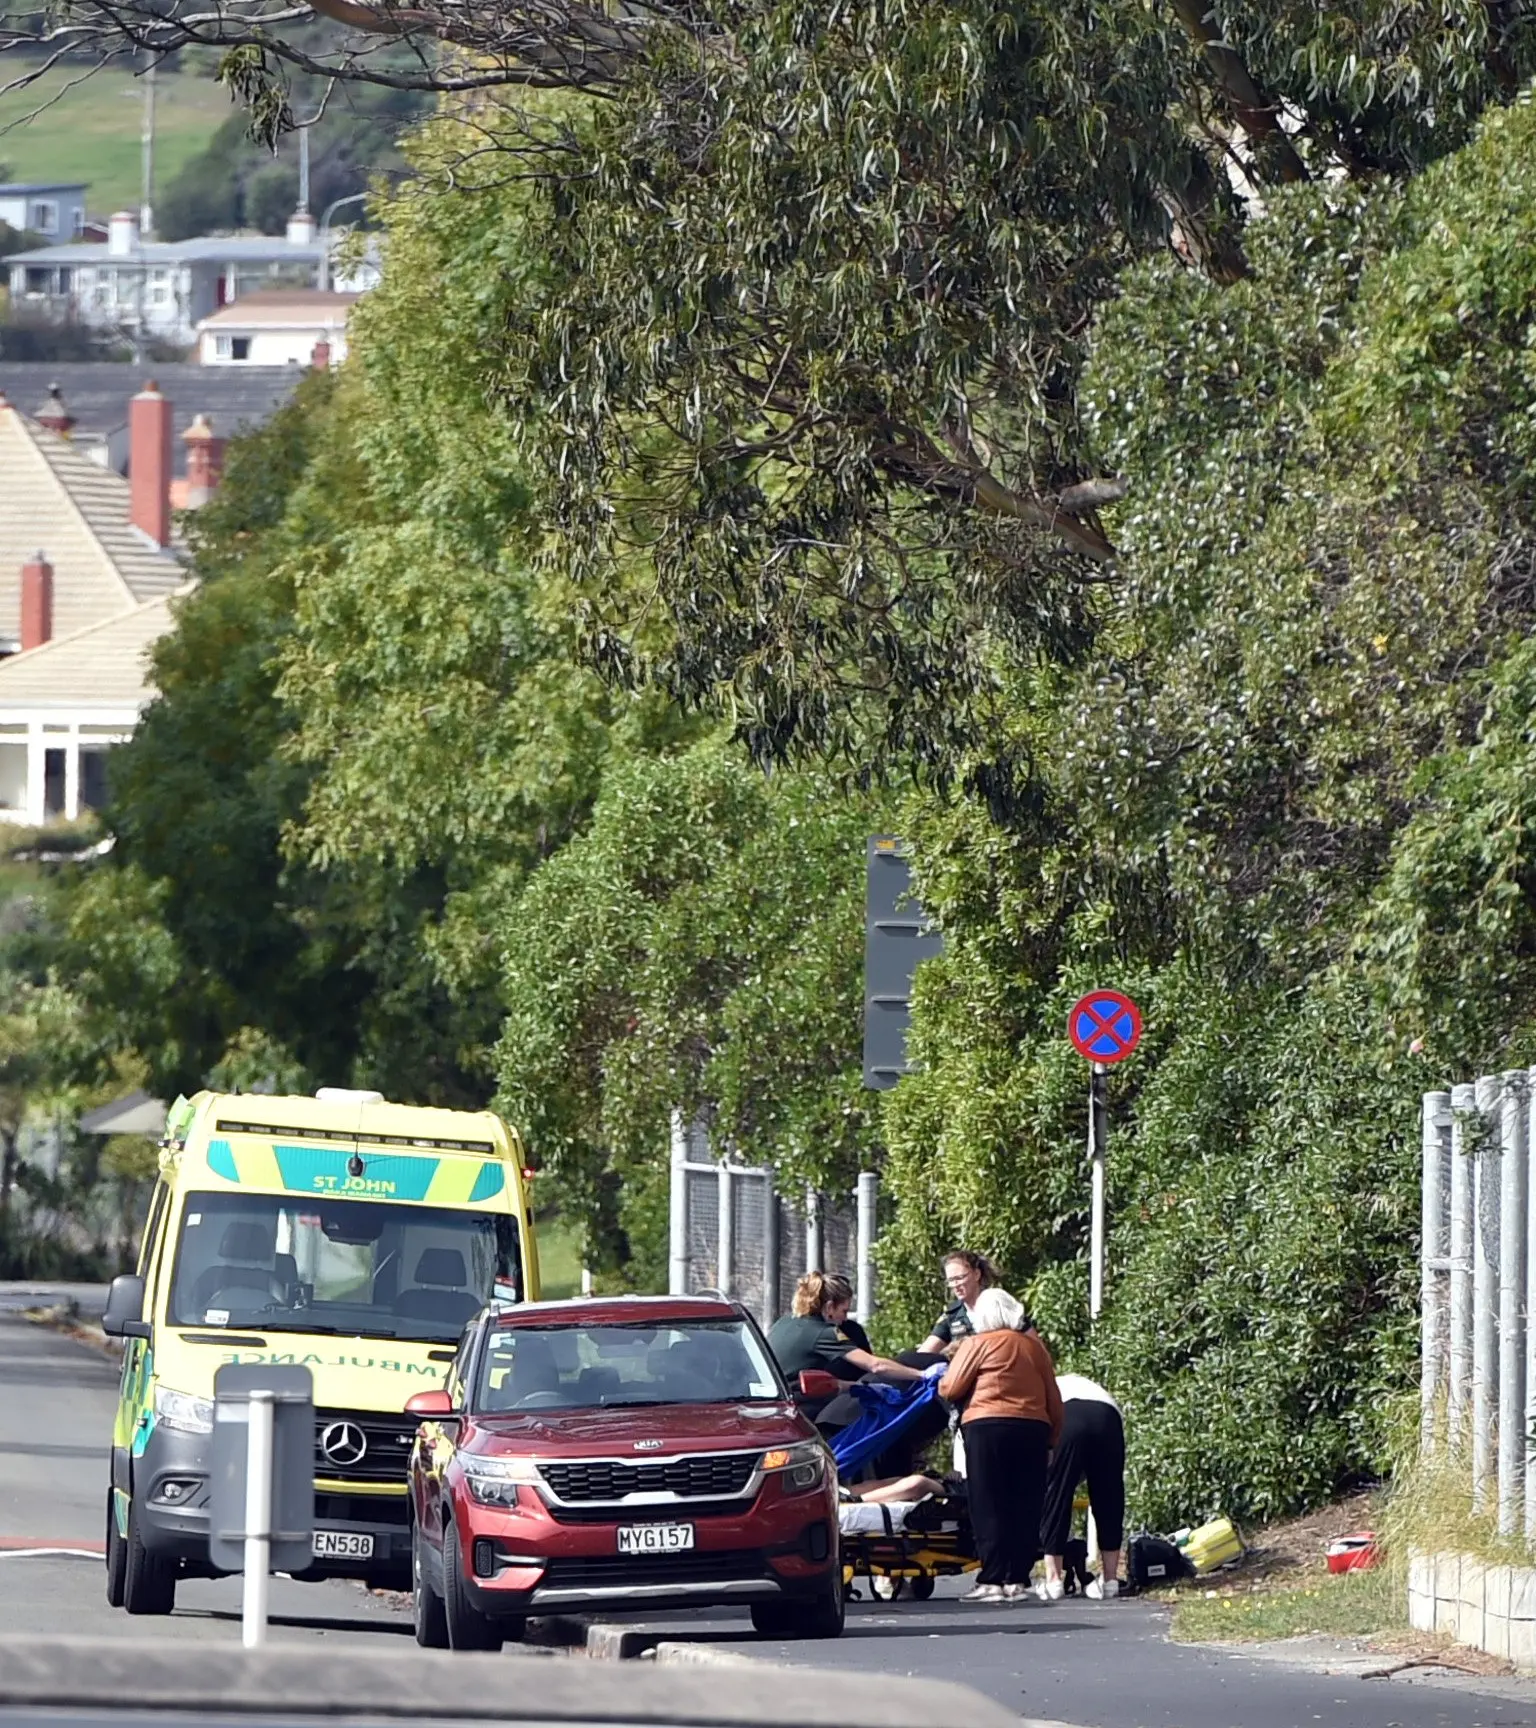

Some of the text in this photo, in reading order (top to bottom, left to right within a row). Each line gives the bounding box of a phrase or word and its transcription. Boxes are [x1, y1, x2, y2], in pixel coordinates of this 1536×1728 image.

[313, 1175, 396, 1193] ST JOHN
[314, 1533, 371, 1555] EN538
[619, 1526, 691, 1550] MYG157
